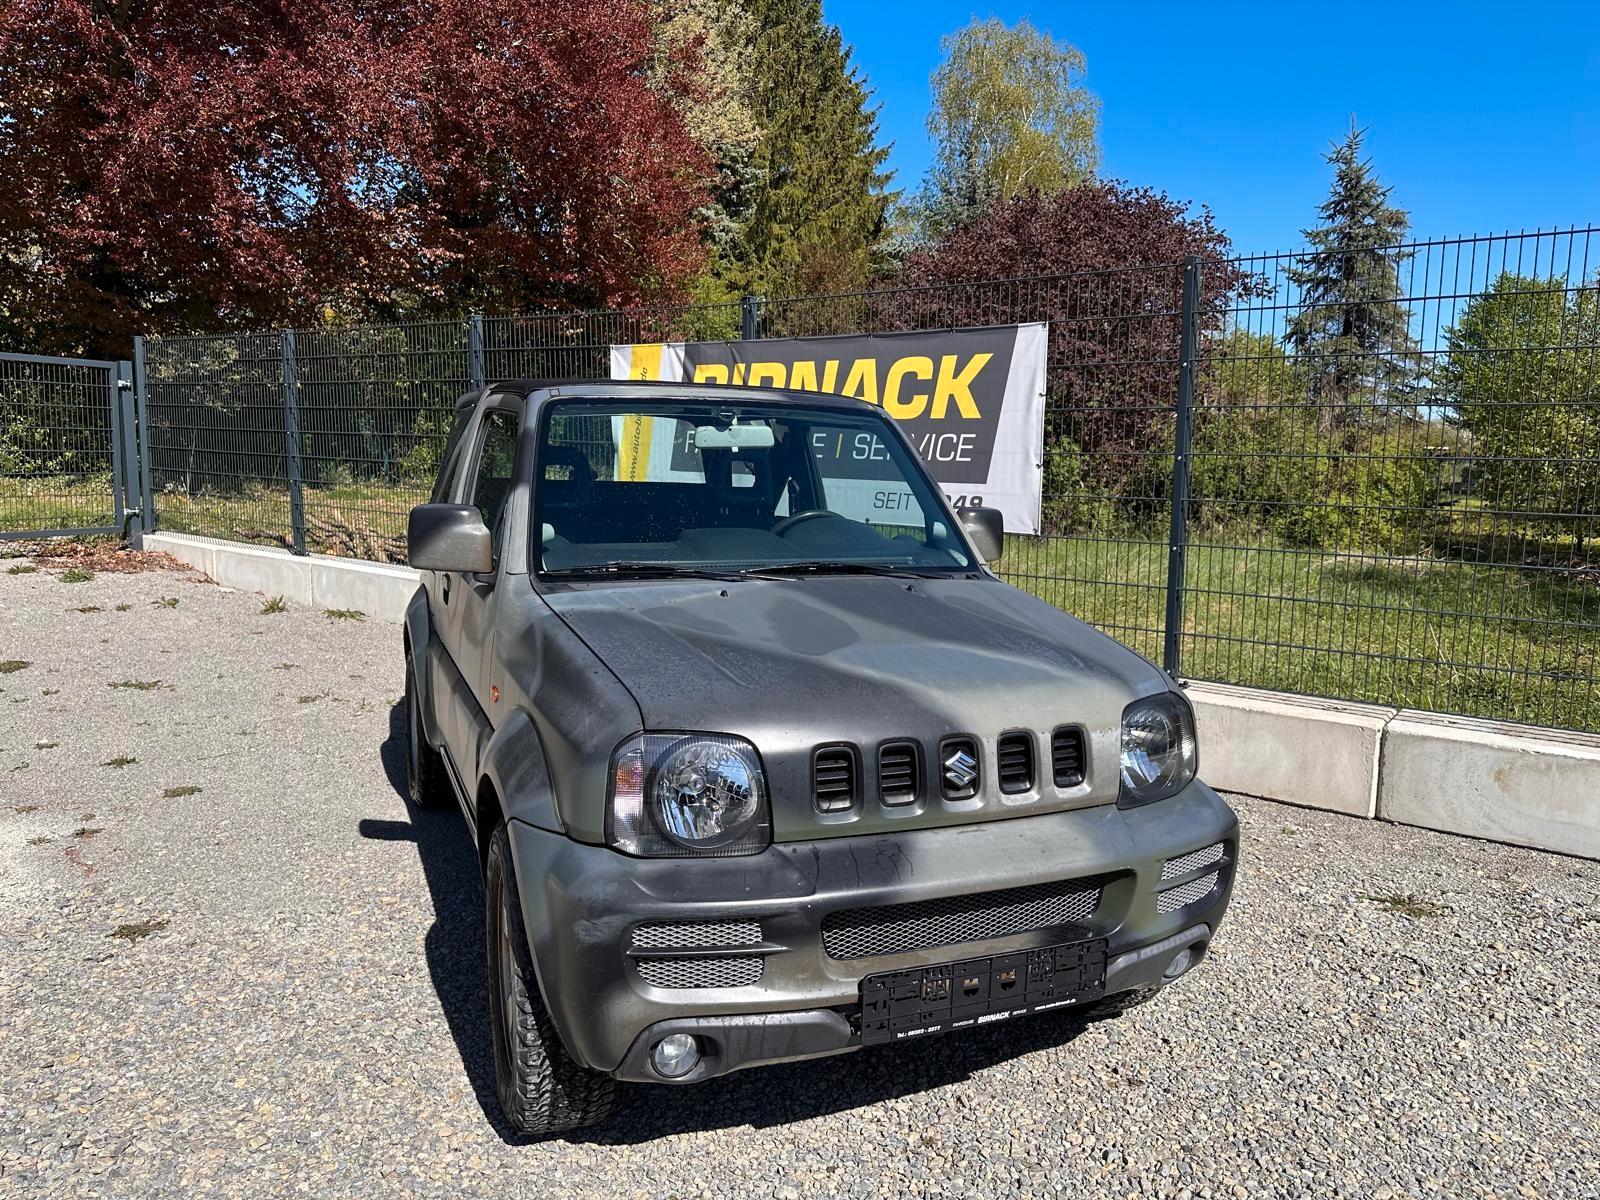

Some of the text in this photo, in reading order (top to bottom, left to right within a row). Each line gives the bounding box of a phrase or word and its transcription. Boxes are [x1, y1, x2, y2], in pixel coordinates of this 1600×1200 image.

[852, 433, 977, 462] SEICE
[873, 491, 915, 511] SEIT
[978, 1010, 1010, 1024] BIRNACK
